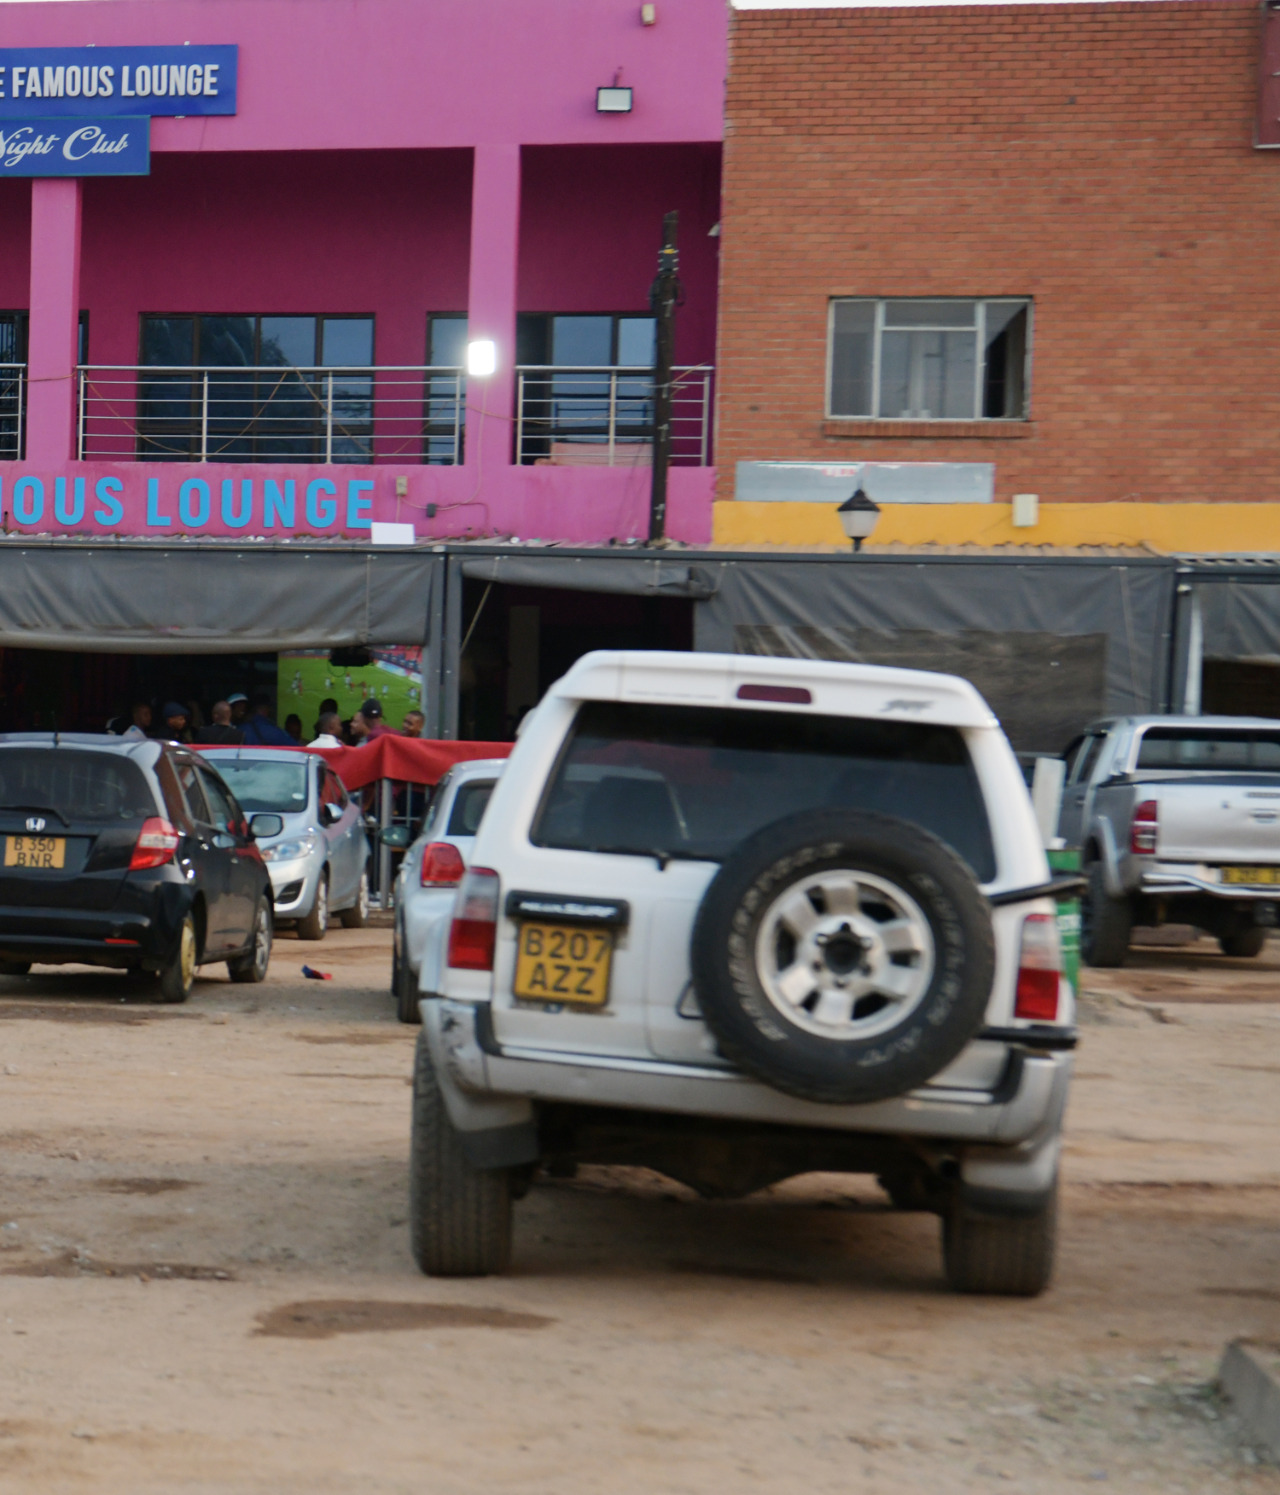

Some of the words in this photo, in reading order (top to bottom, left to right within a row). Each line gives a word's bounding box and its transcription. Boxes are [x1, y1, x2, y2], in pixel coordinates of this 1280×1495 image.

[12, 65, 115, 98] FAMOUS
[121, 64, 220, 97] LOUNGE
[62, 126, 129, 161] Club
[146, 478, 375, 529] LOUNGE
[17, 852, 53, 867] BNR
[528, 962, 596, 996] AZZ
